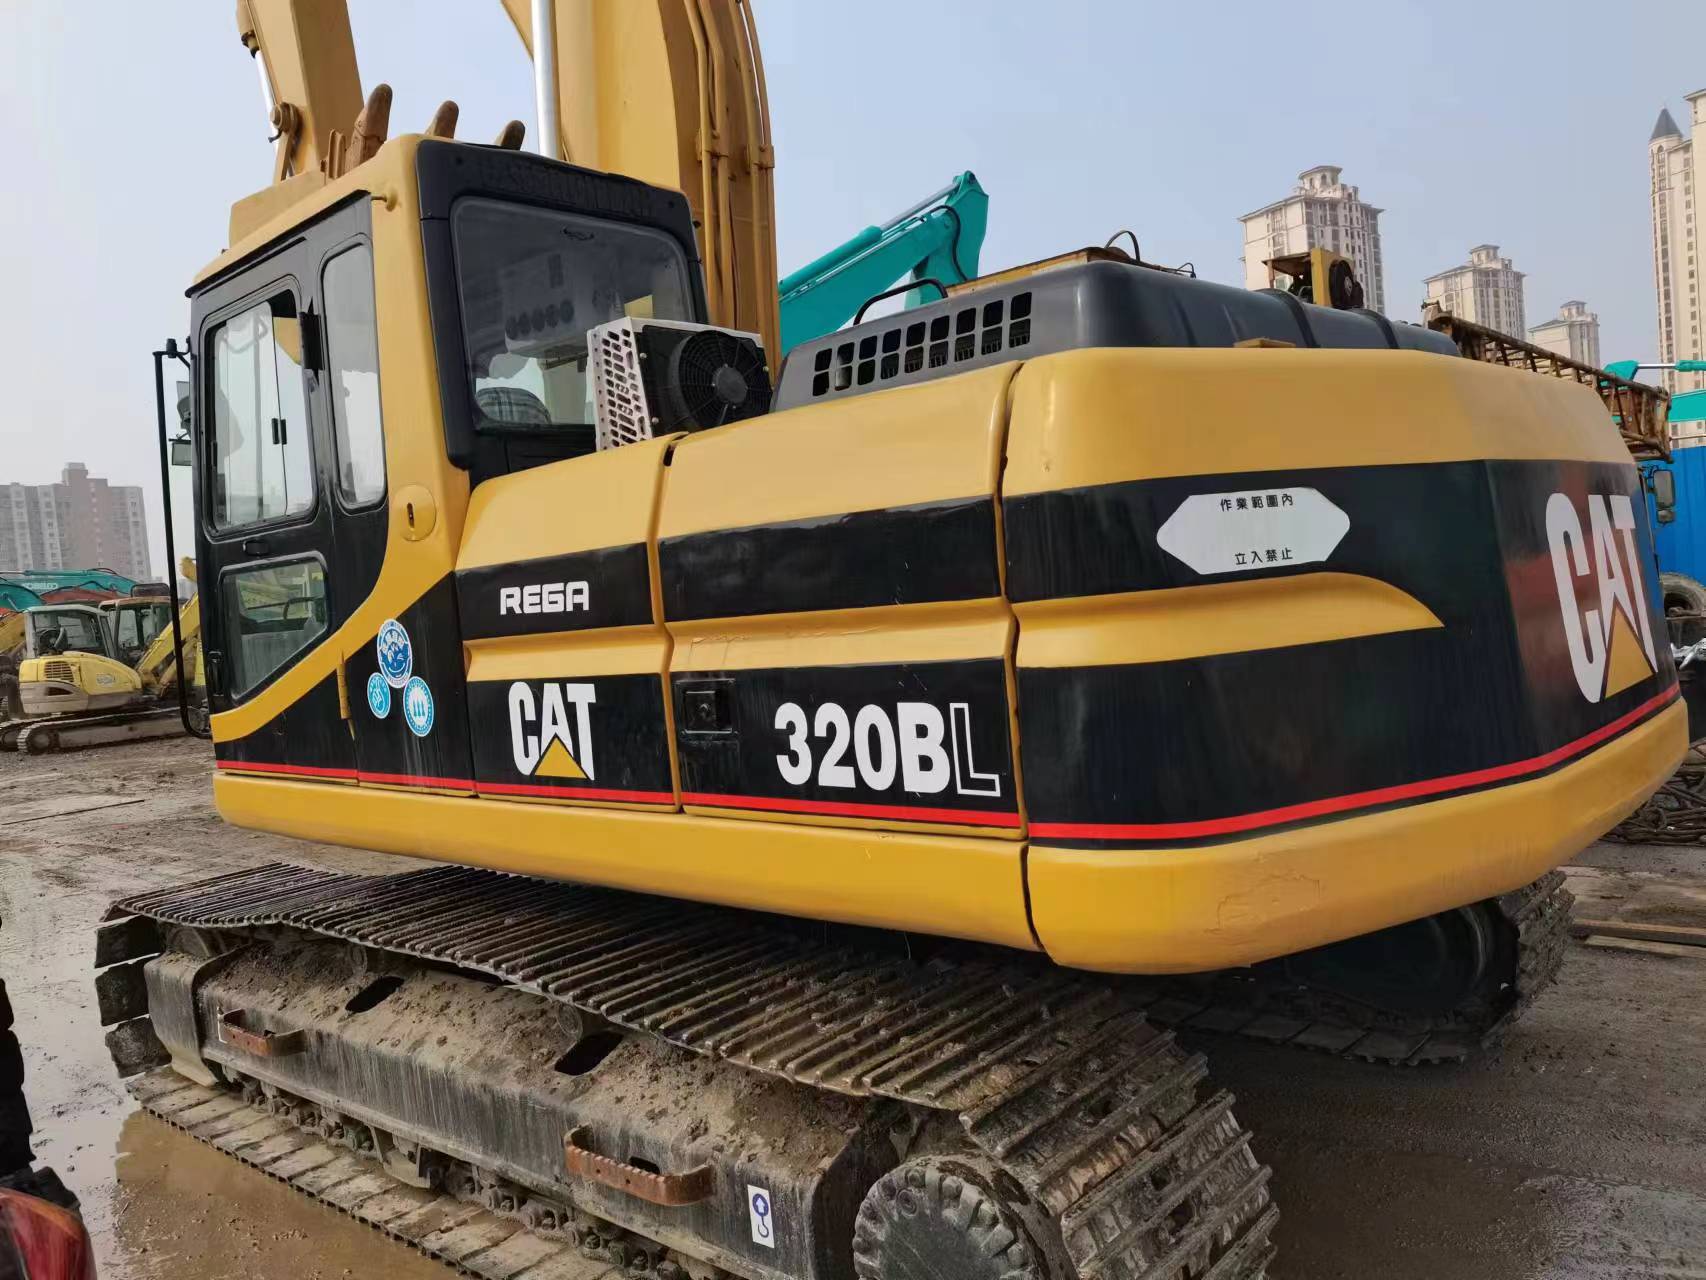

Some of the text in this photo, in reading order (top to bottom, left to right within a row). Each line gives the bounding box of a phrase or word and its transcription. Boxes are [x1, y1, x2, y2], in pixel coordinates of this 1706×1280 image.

[500, 580, 590, 615] REGA
[1234, 547, 1293, 566] 立入禁止
[1545, 492, 1658, 703] CAT
[508, 681, 596, 780] CAT
[774, 702, 1001, 797] 320BL
